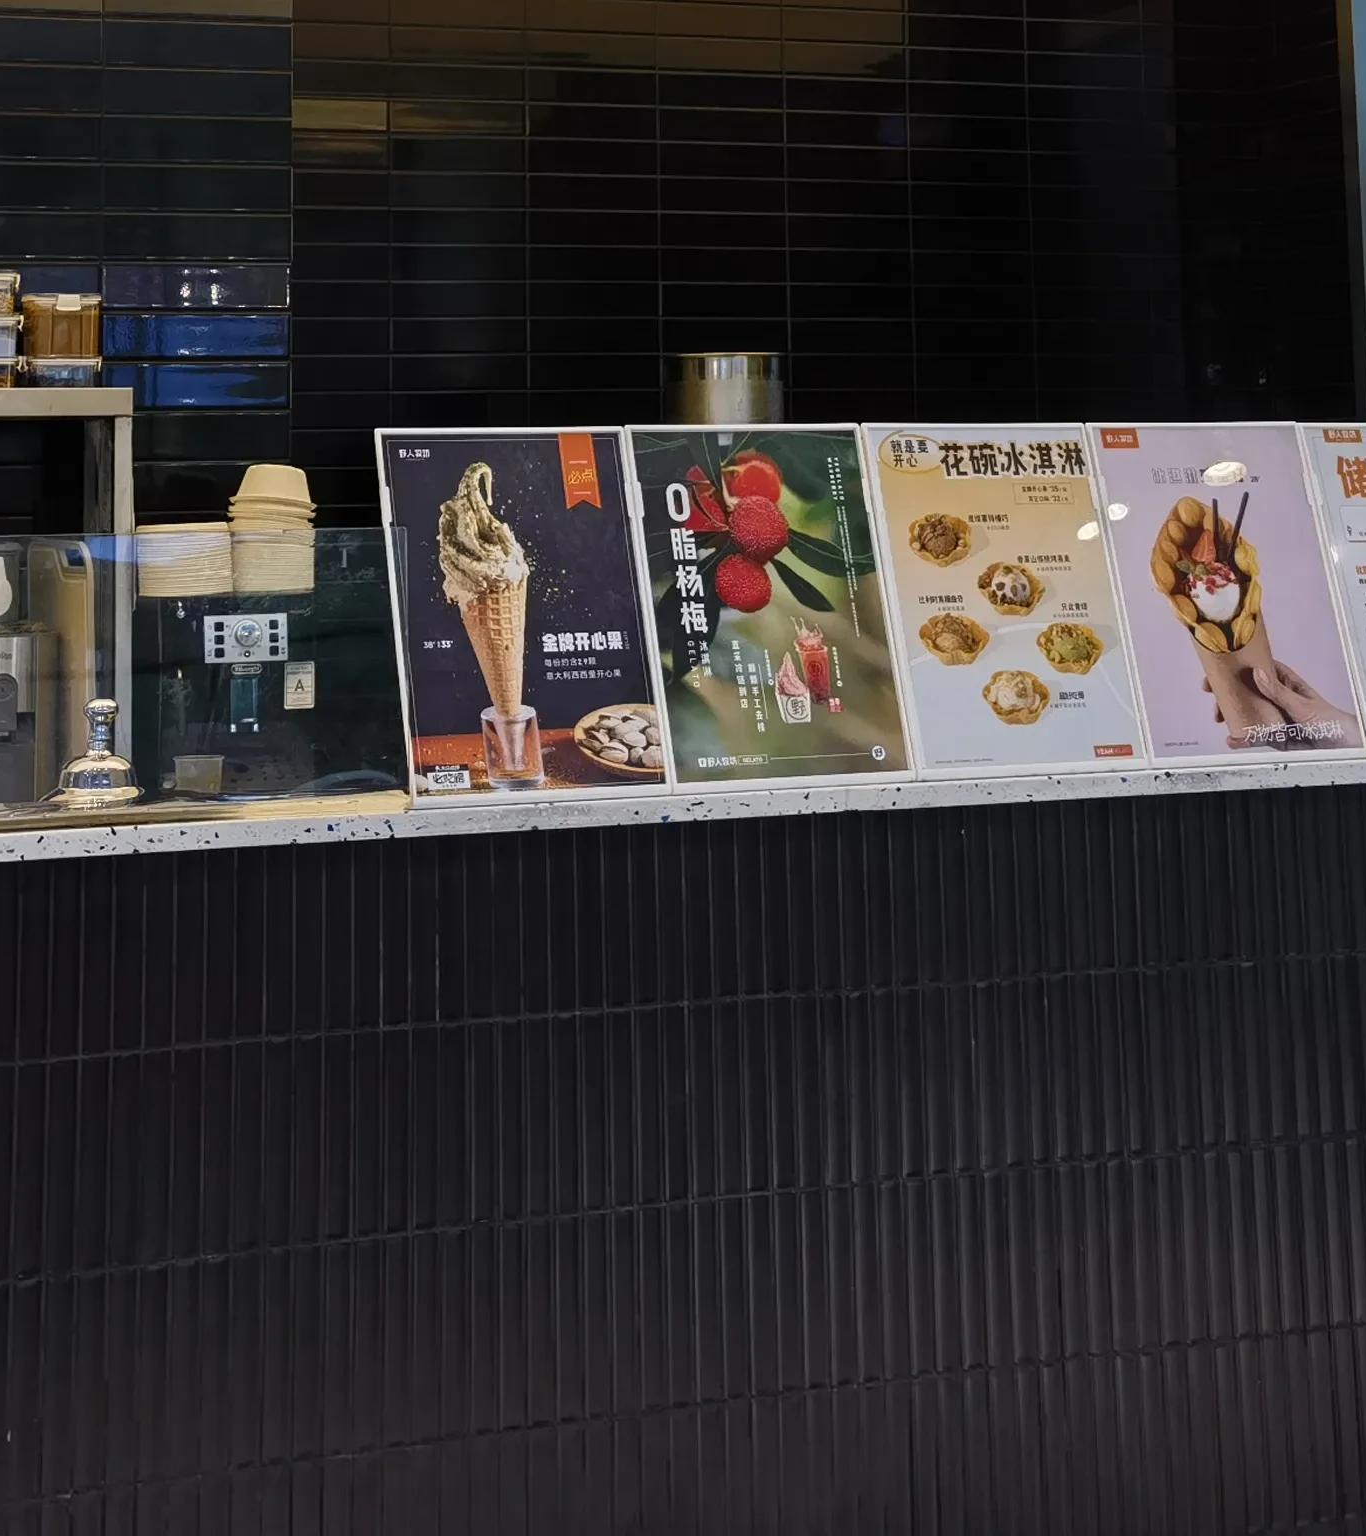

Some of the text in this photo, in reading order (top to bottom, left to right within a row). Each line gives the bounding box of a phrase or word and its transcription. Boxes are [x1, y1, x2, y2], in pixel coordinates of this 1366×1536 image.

[890, 440, 929, 454] 就是要
[893, 454, 918, 468] 开心
[938, 442, 1085, 476] 花碗冰淇淋
[568, 469, 595, 484] 必点
[542, 631, 623, 652] 金牌开心果
[295, 679, 305, 691] A
[1243, 720, 1345, 742] 万物皆可冰淇淋
